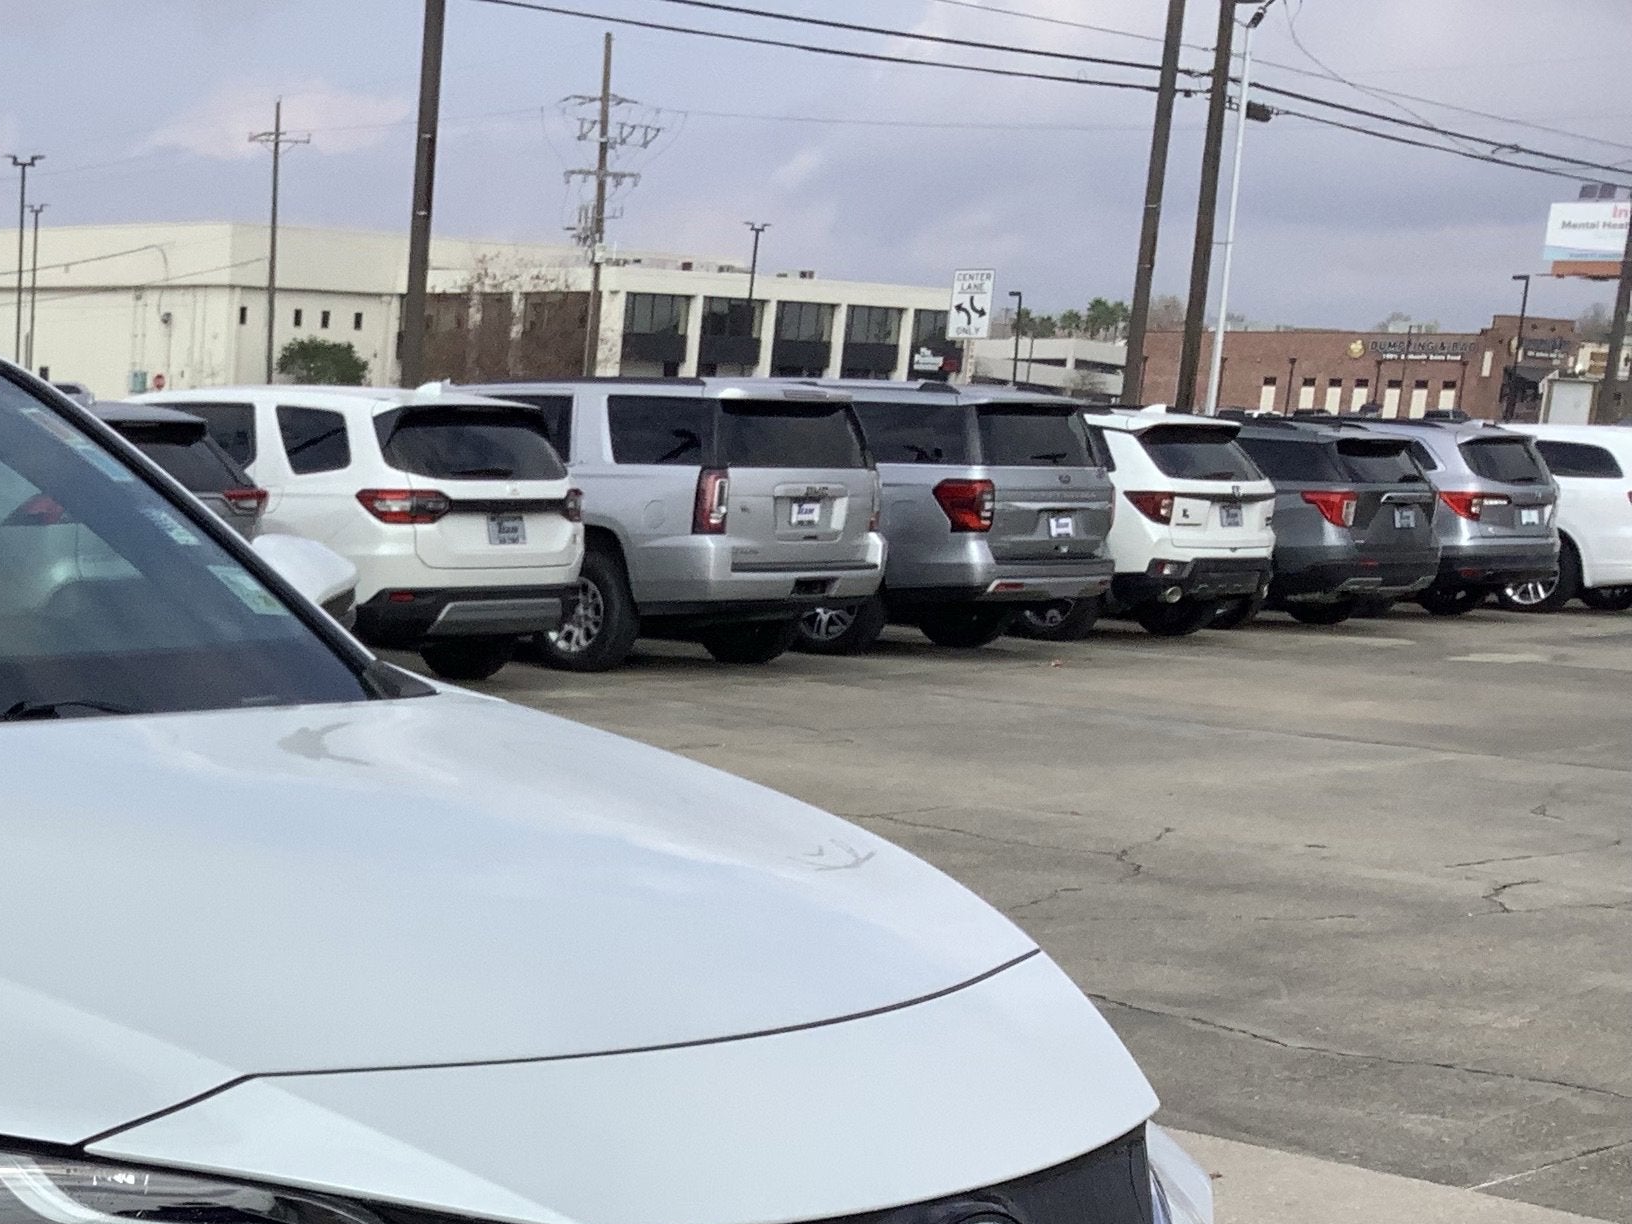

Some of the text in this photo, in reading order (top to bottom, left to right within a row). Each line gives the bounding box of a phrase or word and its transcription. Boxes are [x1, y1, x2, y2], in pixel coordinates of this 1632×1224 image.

[1561, 220, 1600, 230] Mental
[957, 272, 992, 281] CENTER
[961, 282, 985, 291] LANE
[955, 326, 981, 336] ONLY
[1370, 340, 1434, 351] DUMPING
